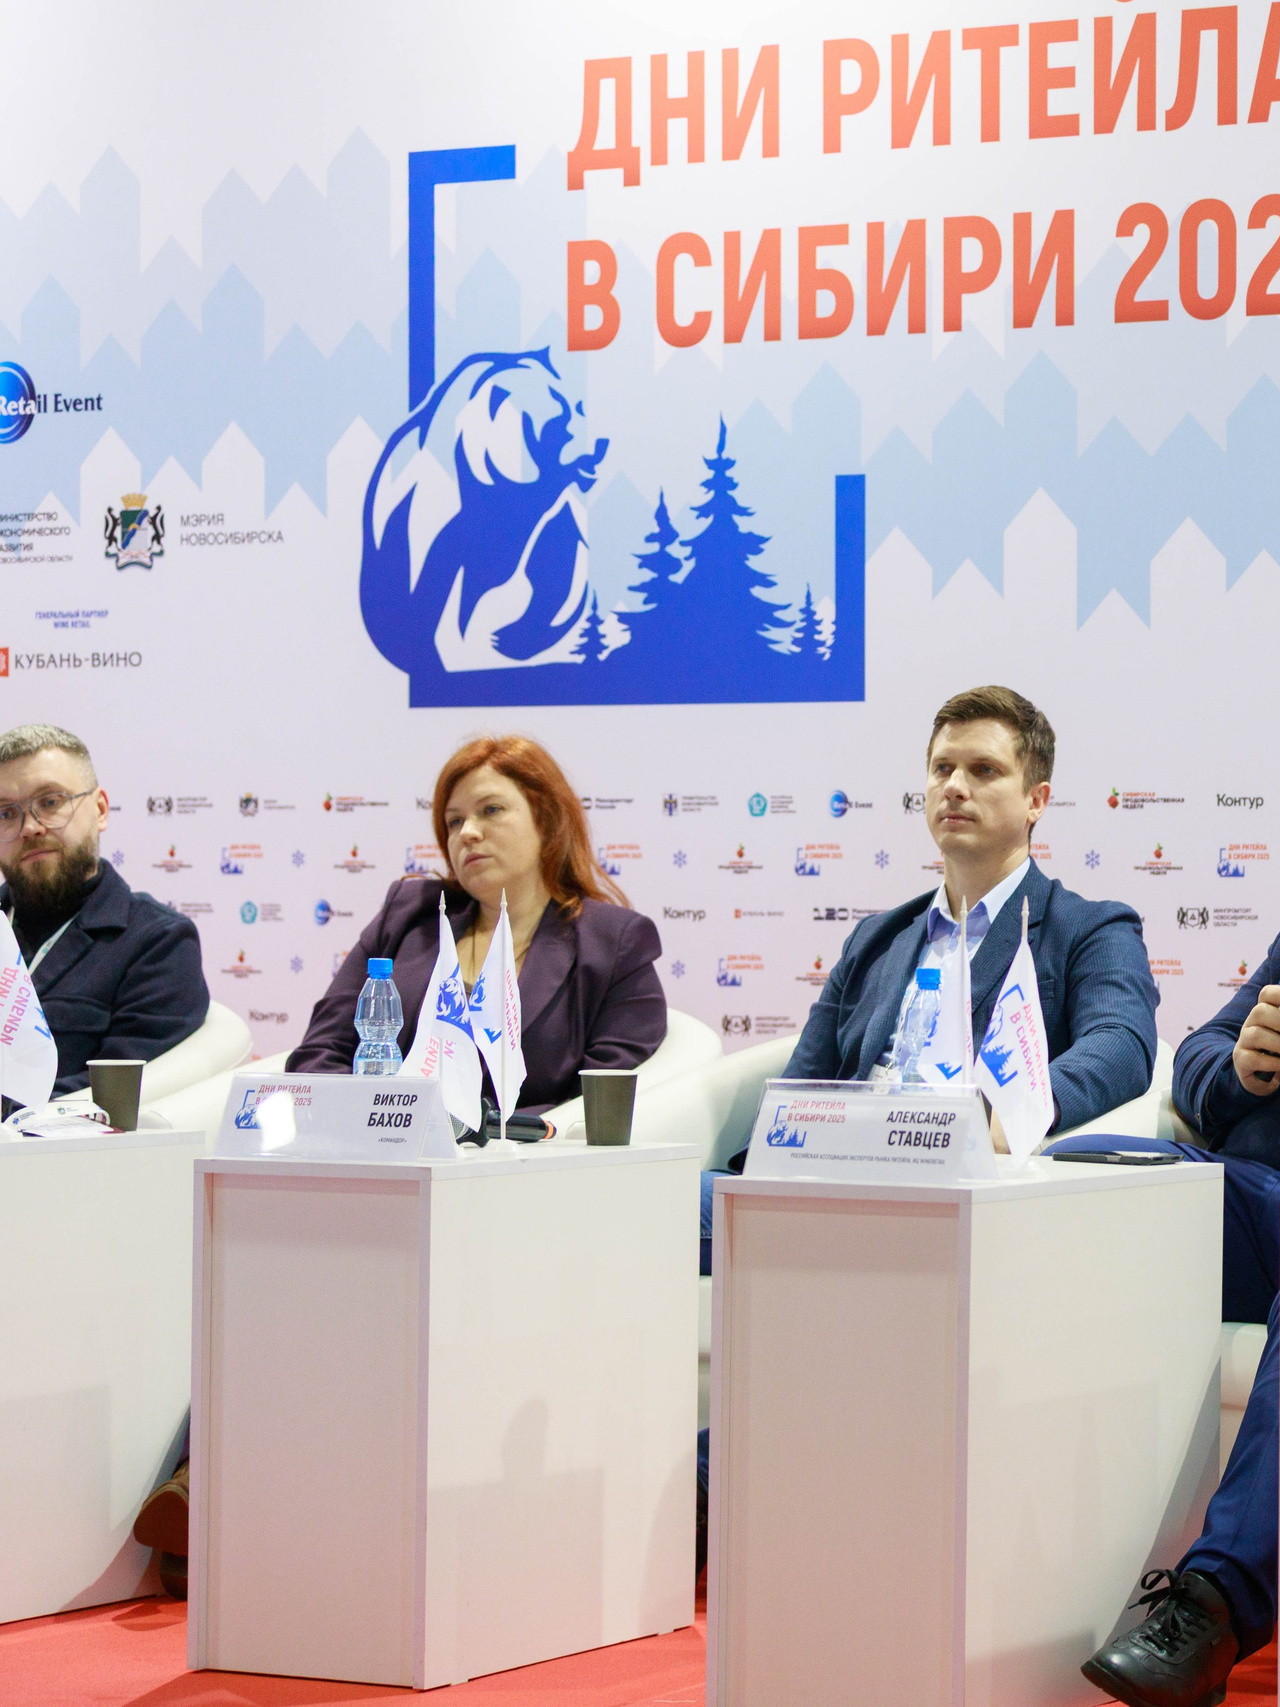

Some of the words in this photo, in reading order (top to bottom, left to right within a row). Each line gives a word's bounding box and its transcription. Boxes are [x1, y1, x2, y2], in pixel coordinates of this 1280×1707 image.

[567, 43, 781, 191] ДНИ
[567, 239, 621, 352] В
[655, 208, 1075, 349] СИБИРИ
[54, 393, 103, 412] Event
[180, 513, 225, 527] МЭРИЯ
[0, 526, 71, 537] КОНОМИЧЕСКОГО
[180, 531, 284, 546] НОВОСИБИРСКА
[14, 652, 143, 669] КУБАНЬ-ВИНО
[1216, 794, 1264, 809] Контур
[1010, 1011, 1021, 1024] В
[1016, 1027, 1037, 1091] СИБИРИ
[258, 1085, 276, 1094] ДНИ
[294, 1098, 312, 1106] 2025
[373, 1094, 418, 1107] ВИКТОР
[790, 1100, 808, 1109] ДНИ
[810, 1099, 846, 1111] РИТЕЙЛА
[367, 1113, 412, 1128] БАХОВ
[787, 1113, 792, 1122] В
[794, 1113, 825, 1123] СИБИРИ
[827, 1114, 846, 1123] 2025
[886, 1111, 956, 1125] АЛЕКСАНДР
[887, 1130, 951, 1148] СТАВЦЕВ
